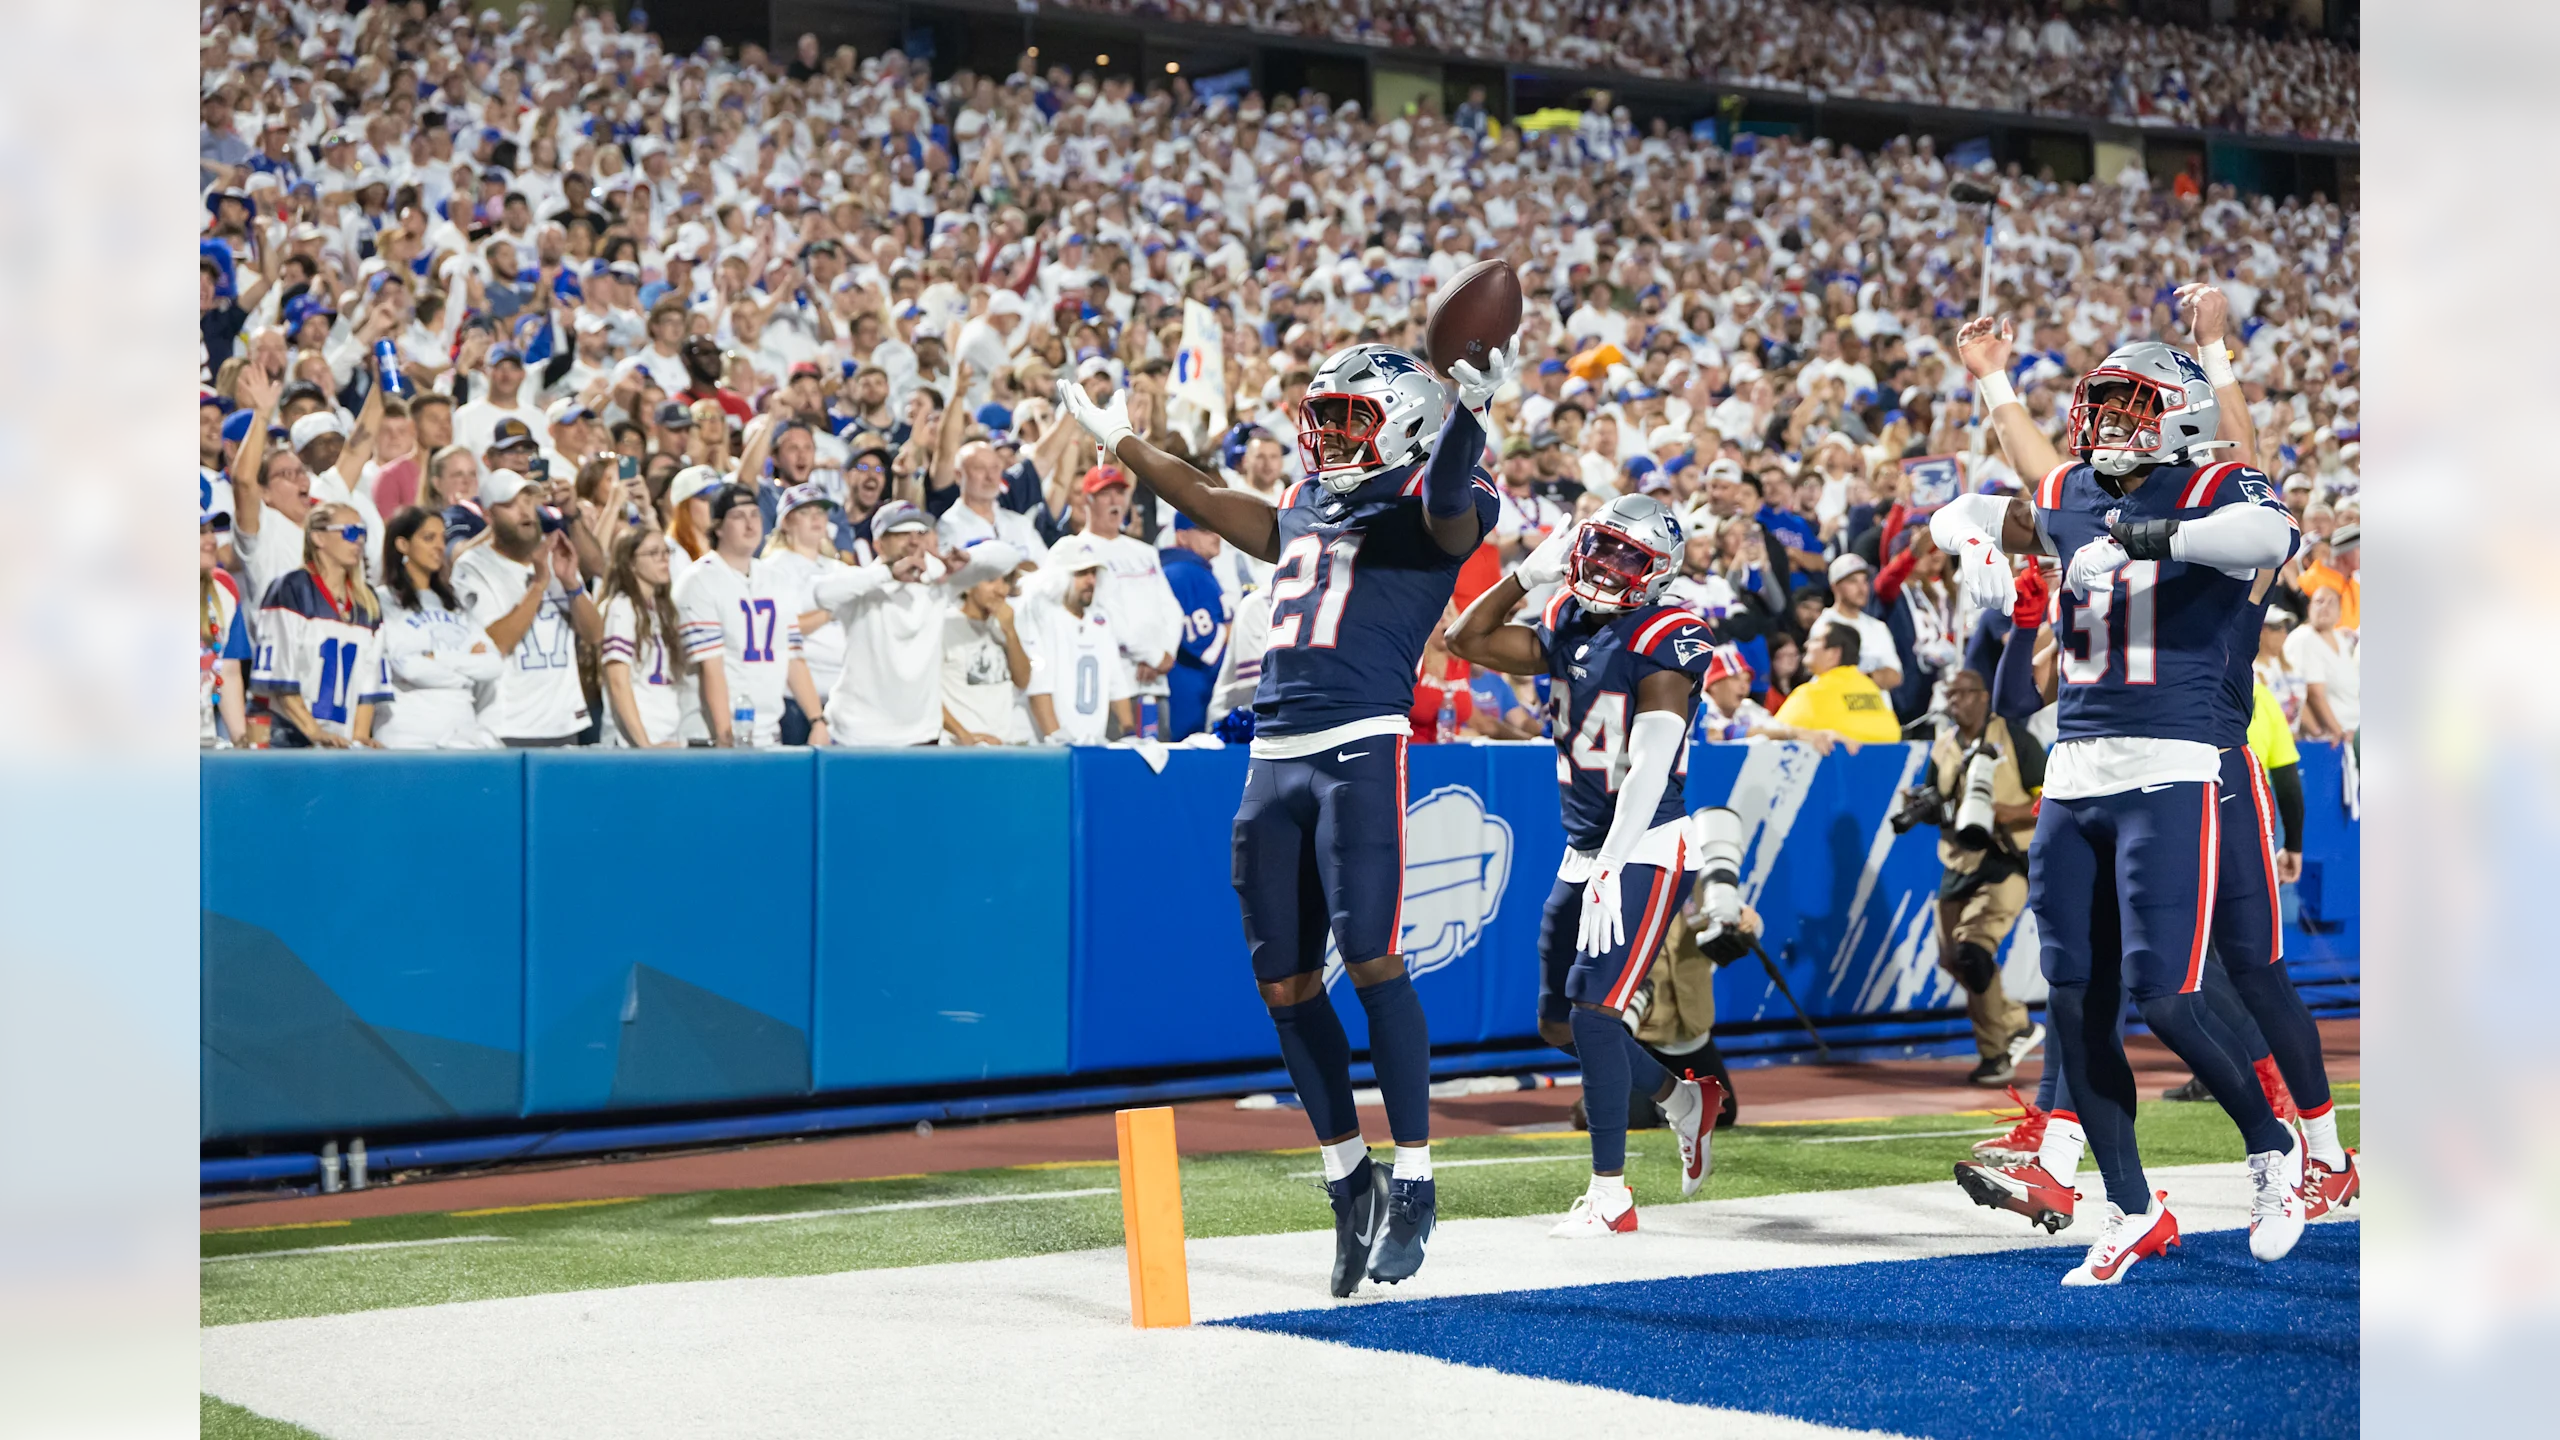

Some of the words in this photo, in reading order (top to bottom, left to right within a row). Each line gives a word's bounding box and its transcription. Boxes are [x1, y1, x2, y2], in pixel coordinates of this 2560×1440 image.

[740, 598, 777, 662] 17
[1266, 531, 1367, 649] 21
[2061, 559, 2160, 685] 31
[1549, 677, 1634, 794] 24
